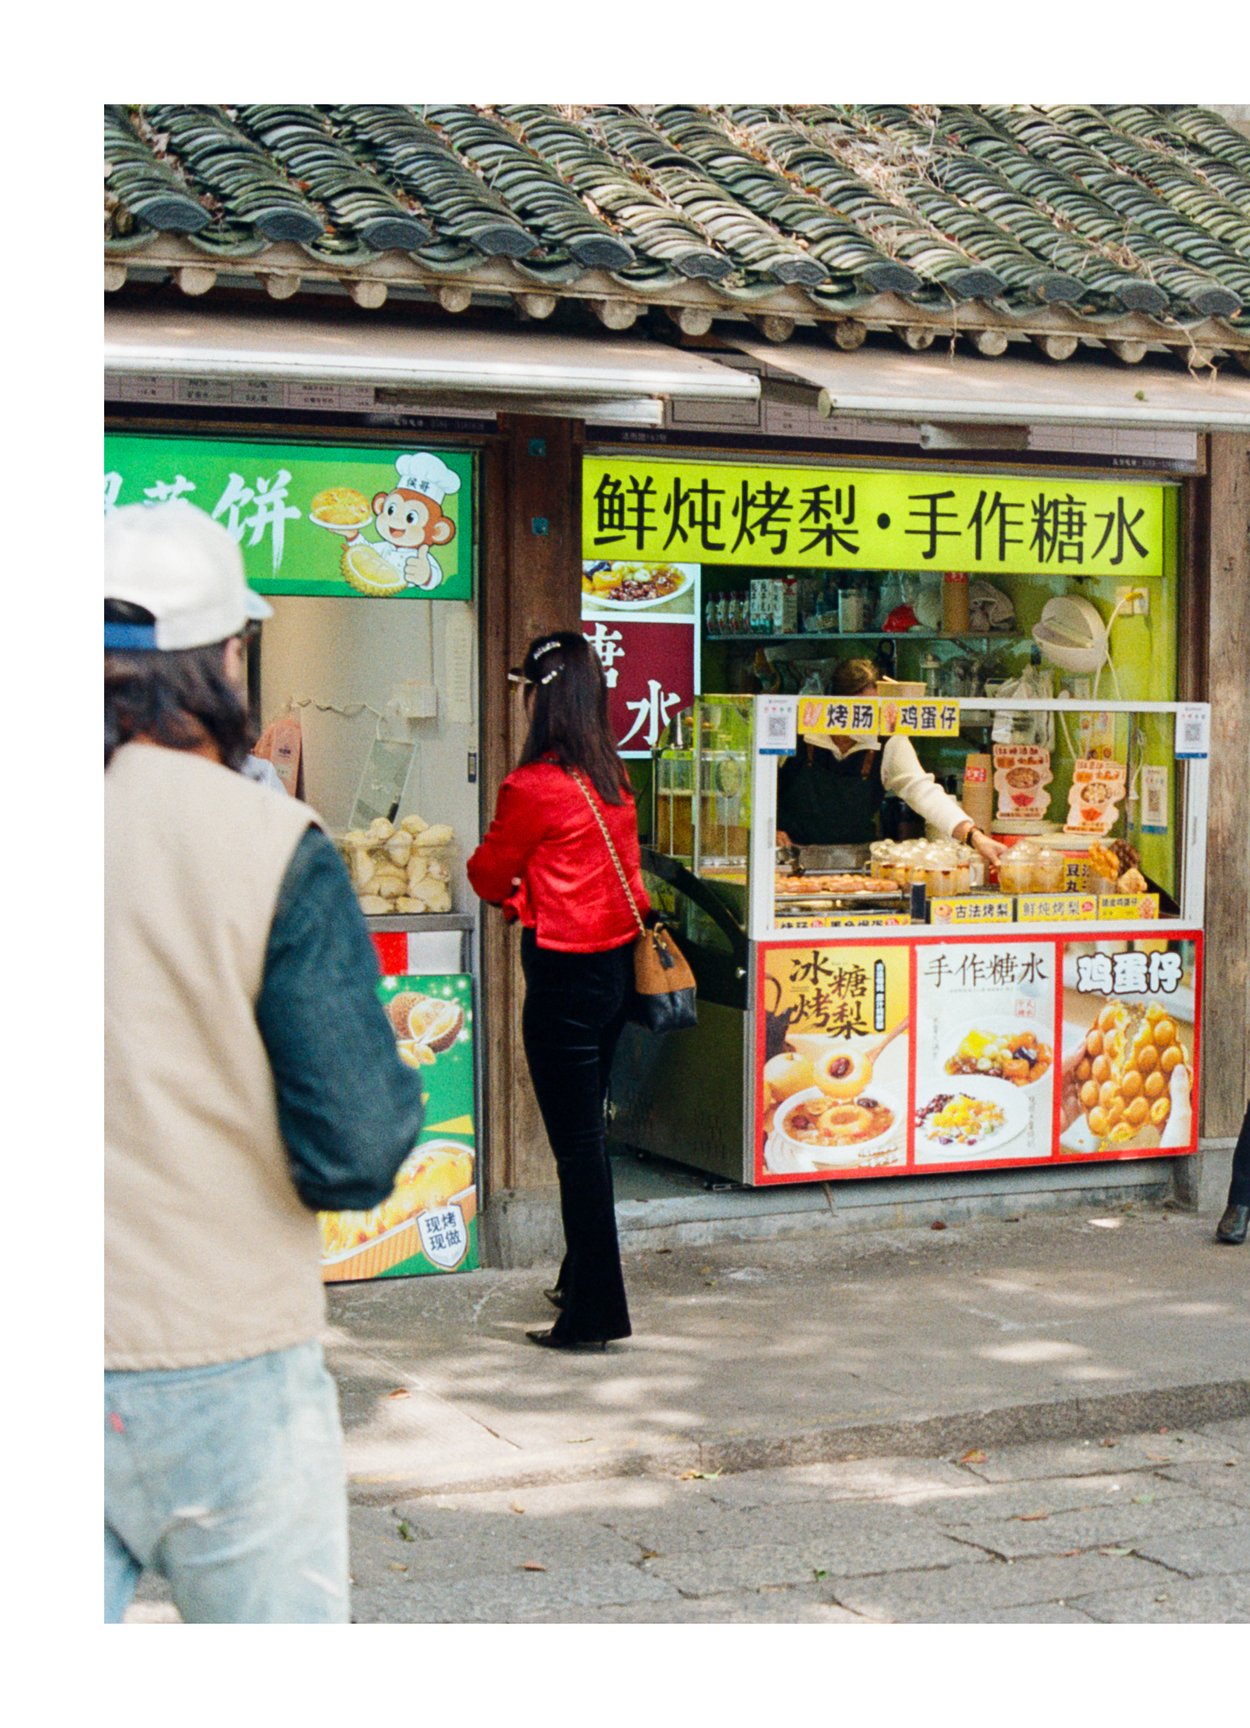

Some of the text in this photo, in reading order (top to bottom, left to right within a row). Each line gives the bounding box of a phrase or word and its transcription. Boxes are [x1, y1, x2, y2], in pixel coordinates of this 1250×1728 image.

[826, 704, 874, 728] 烤肠
[901, 705, 957, 730] 鸡蛋仔
[955, 903, 1008, 919] 古法烤梨
[789, 950, 872, 1000] 冰糖
[923, 952, 1049, 989] 手作糖水
[1076, 950, 1184, 995] 鸡蛋仔
[788, 988, 870, 1040] 烤梨
[425, 1211, 457, 1233] 现烤
[429, 1230, 461, 1250] 现做
